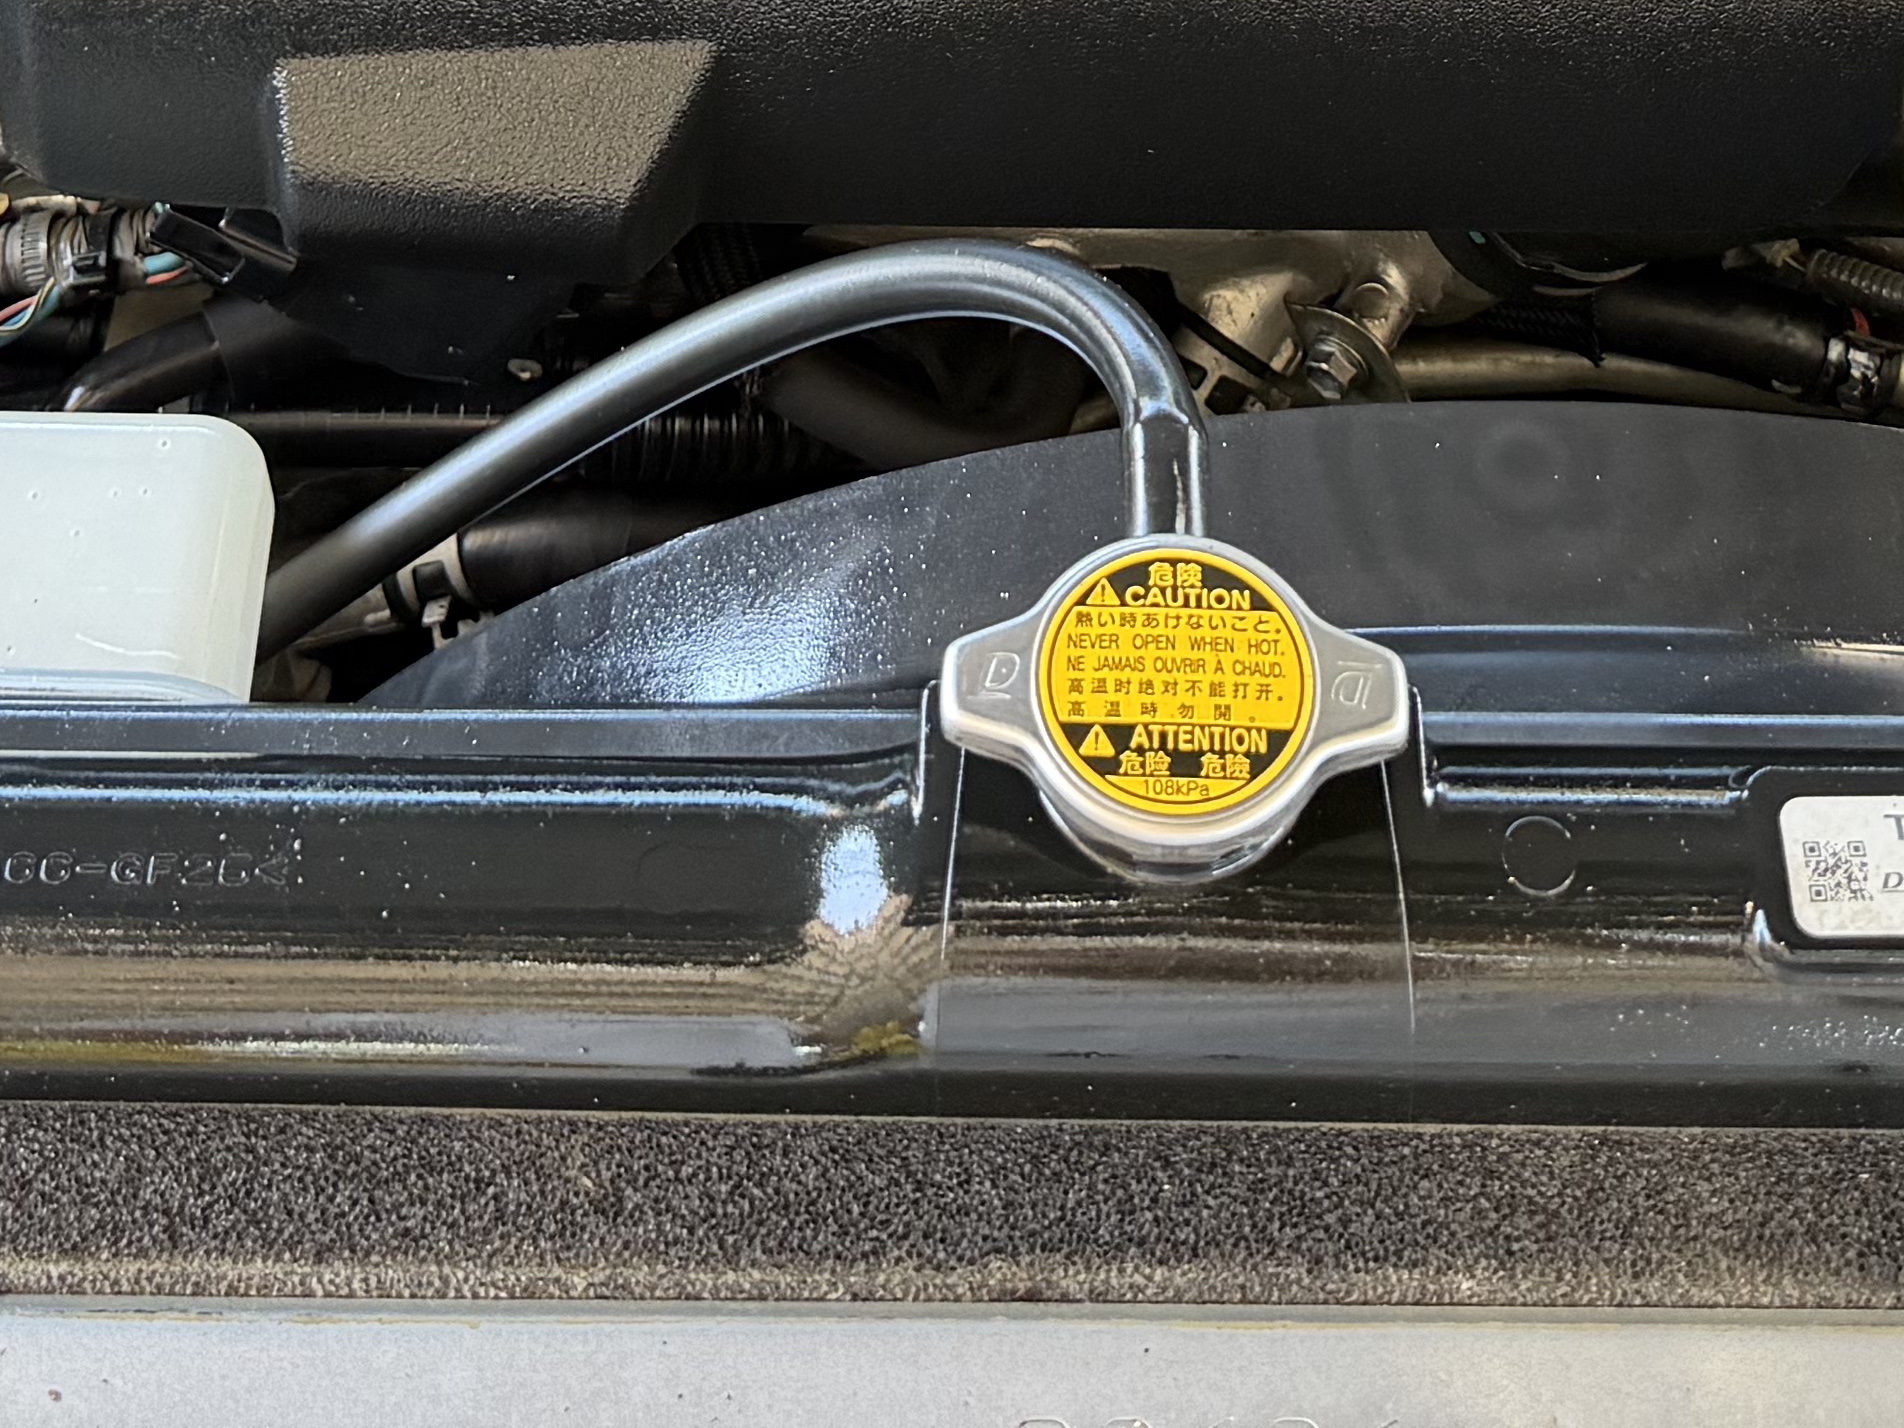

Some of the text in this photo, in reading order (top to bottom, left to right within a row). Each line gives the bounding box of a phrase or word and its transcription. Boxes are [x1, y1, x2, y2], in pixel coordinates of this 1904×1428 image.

[1148, 561, 1204, 588] 危険
[1124, 585, 1252, 611] CAUTION
[1066, 633, 1286, 657] NEVER OPEN WHEN HOT.
[1066, 652, 1287, 679] NE JAMAIS OUVRIR À CHAUD.
[1129, 723, 1269, 754] ATTENTION
[1143, 779, 1211, 797] 108kPa
